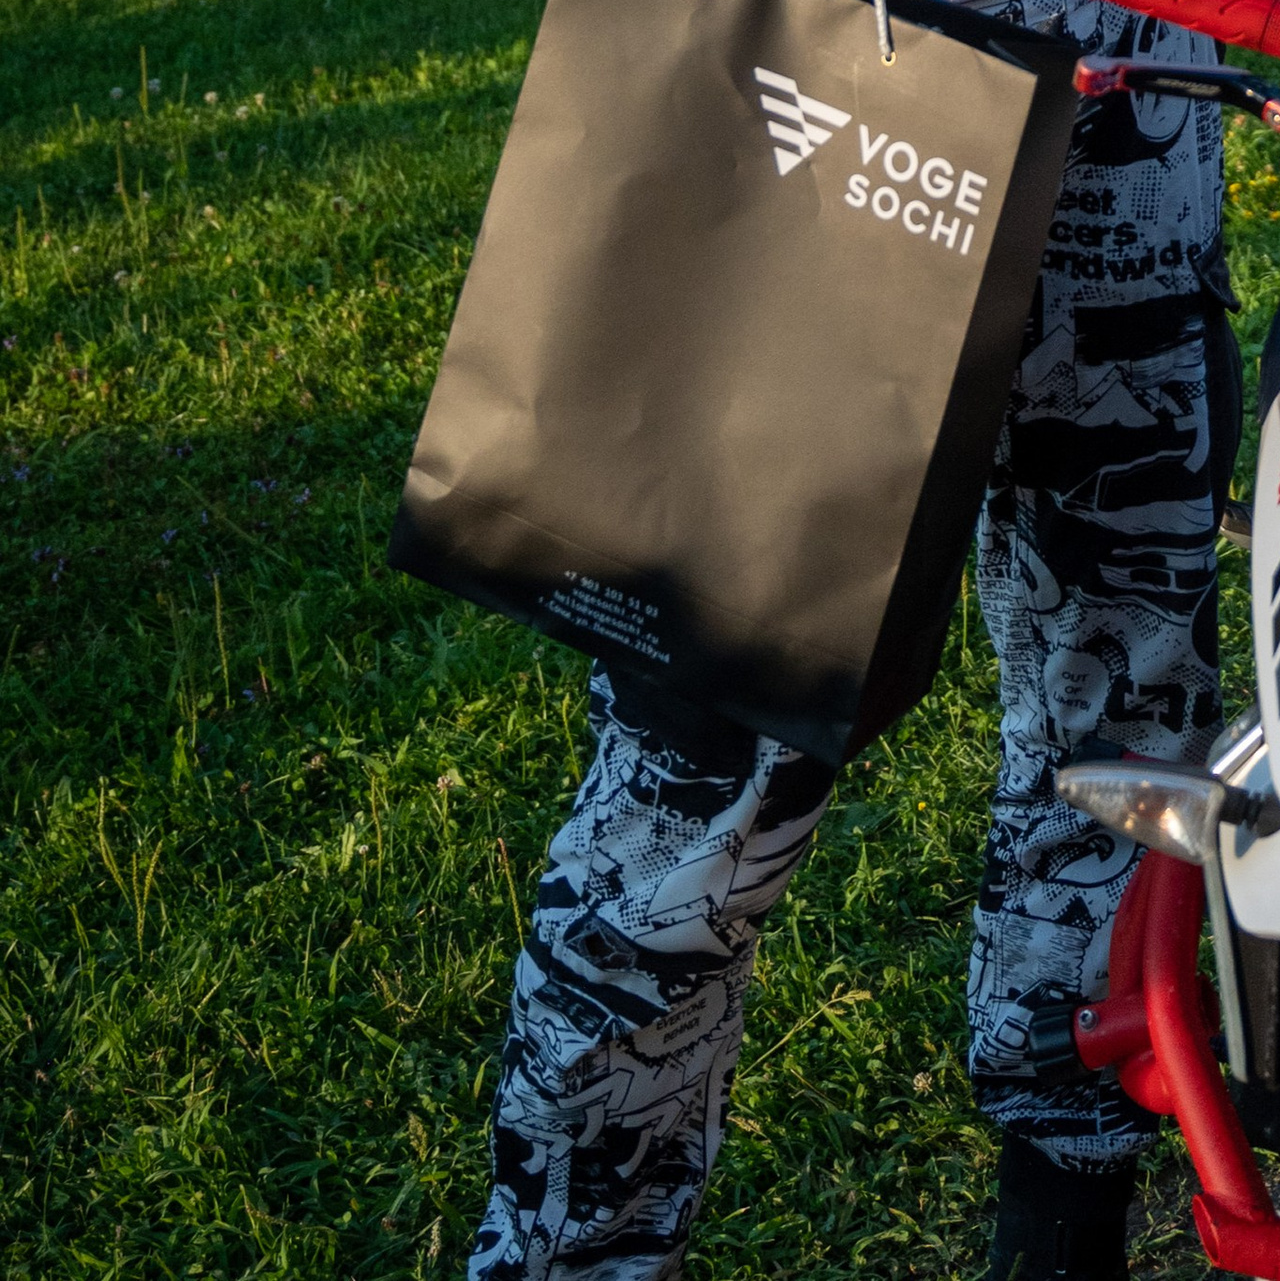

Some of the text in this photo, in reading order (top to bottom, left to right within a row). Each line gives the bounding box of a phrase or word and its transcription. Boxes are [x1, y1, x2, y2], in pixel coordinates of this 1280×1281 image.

[859, 124, 988, 217] VOGE
[844, 173, 975, 256] SOCHI
[1049, 221, 1138, 248] cers
[1061, 671, 1089, 683] OUT
[1065, 686, 1082, 695] OF
[656, 997, 708, 1031] EVERYONE
